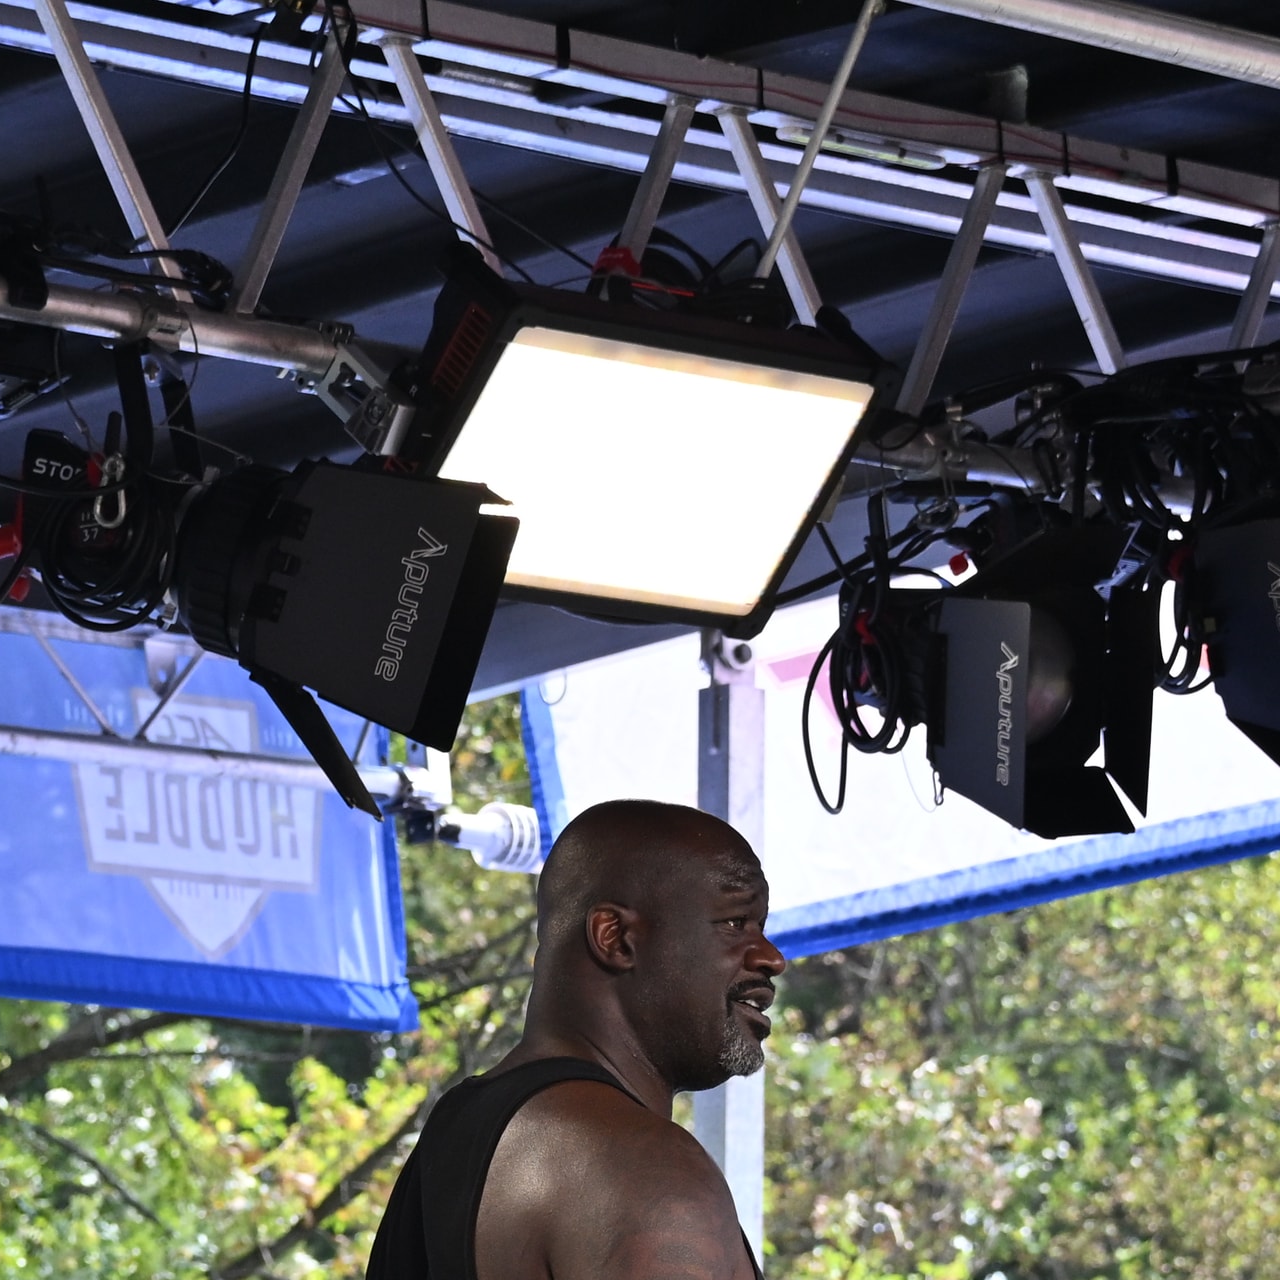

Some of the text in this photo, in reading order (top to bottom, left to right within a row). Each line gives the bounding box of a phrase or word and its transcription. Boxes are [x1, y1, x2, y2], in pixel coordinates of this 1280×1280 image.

[32, 458, 83, 482] STO
[374, 527, 448, 682] Aputure
[996, 641, 1019, 787] Aputure
